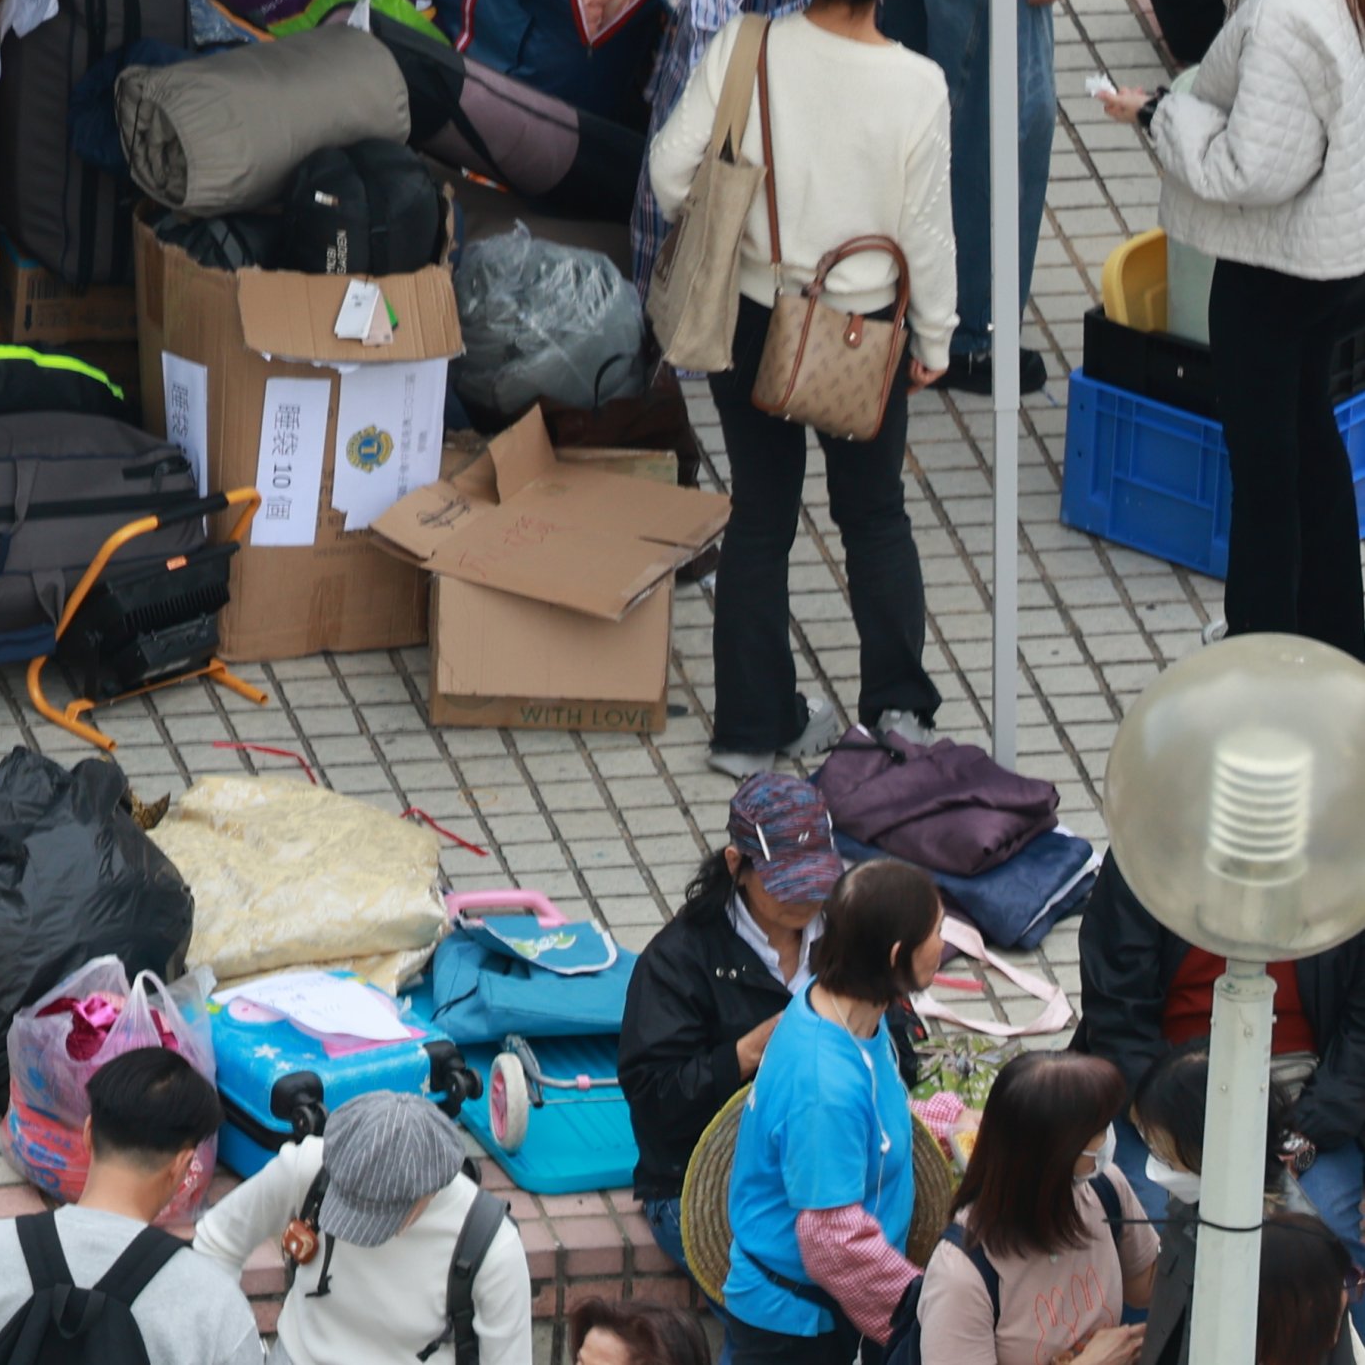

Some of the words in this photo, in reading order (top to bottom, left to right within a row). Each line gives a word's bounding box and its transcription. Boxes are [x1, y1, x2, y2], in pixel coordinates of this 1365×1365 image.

[271, 463, 294, 490] 10
[520, 706, 582, 725] WITH
[593, 708, 654, 728] LOVE
